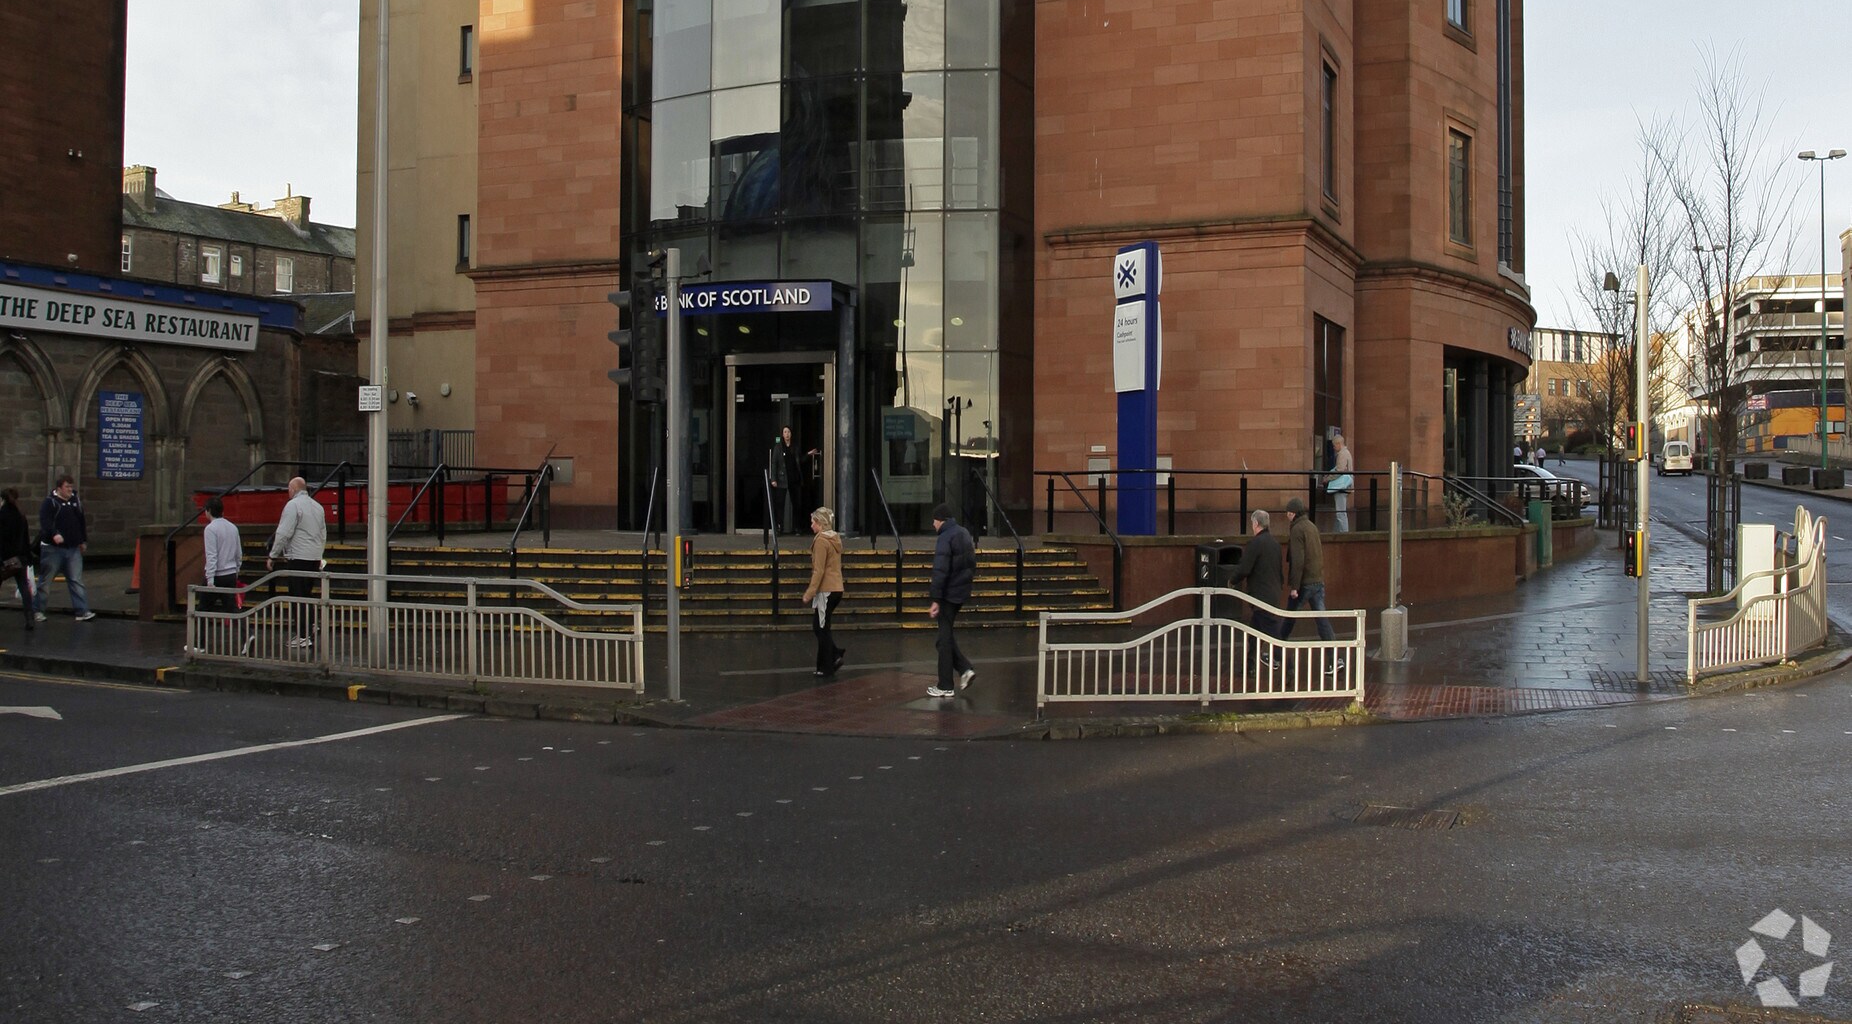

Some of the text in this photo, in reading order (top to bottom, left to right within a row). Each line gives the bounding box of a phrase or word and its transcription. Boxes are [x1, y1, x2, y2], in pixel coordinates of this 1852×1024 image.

[661, 288, 811, 311] BNK OF SCOTLAND
[0, 295, 253, 342] THE DEEP SEA RESTAURANT
[1124, 317, 1138, 326] hours
